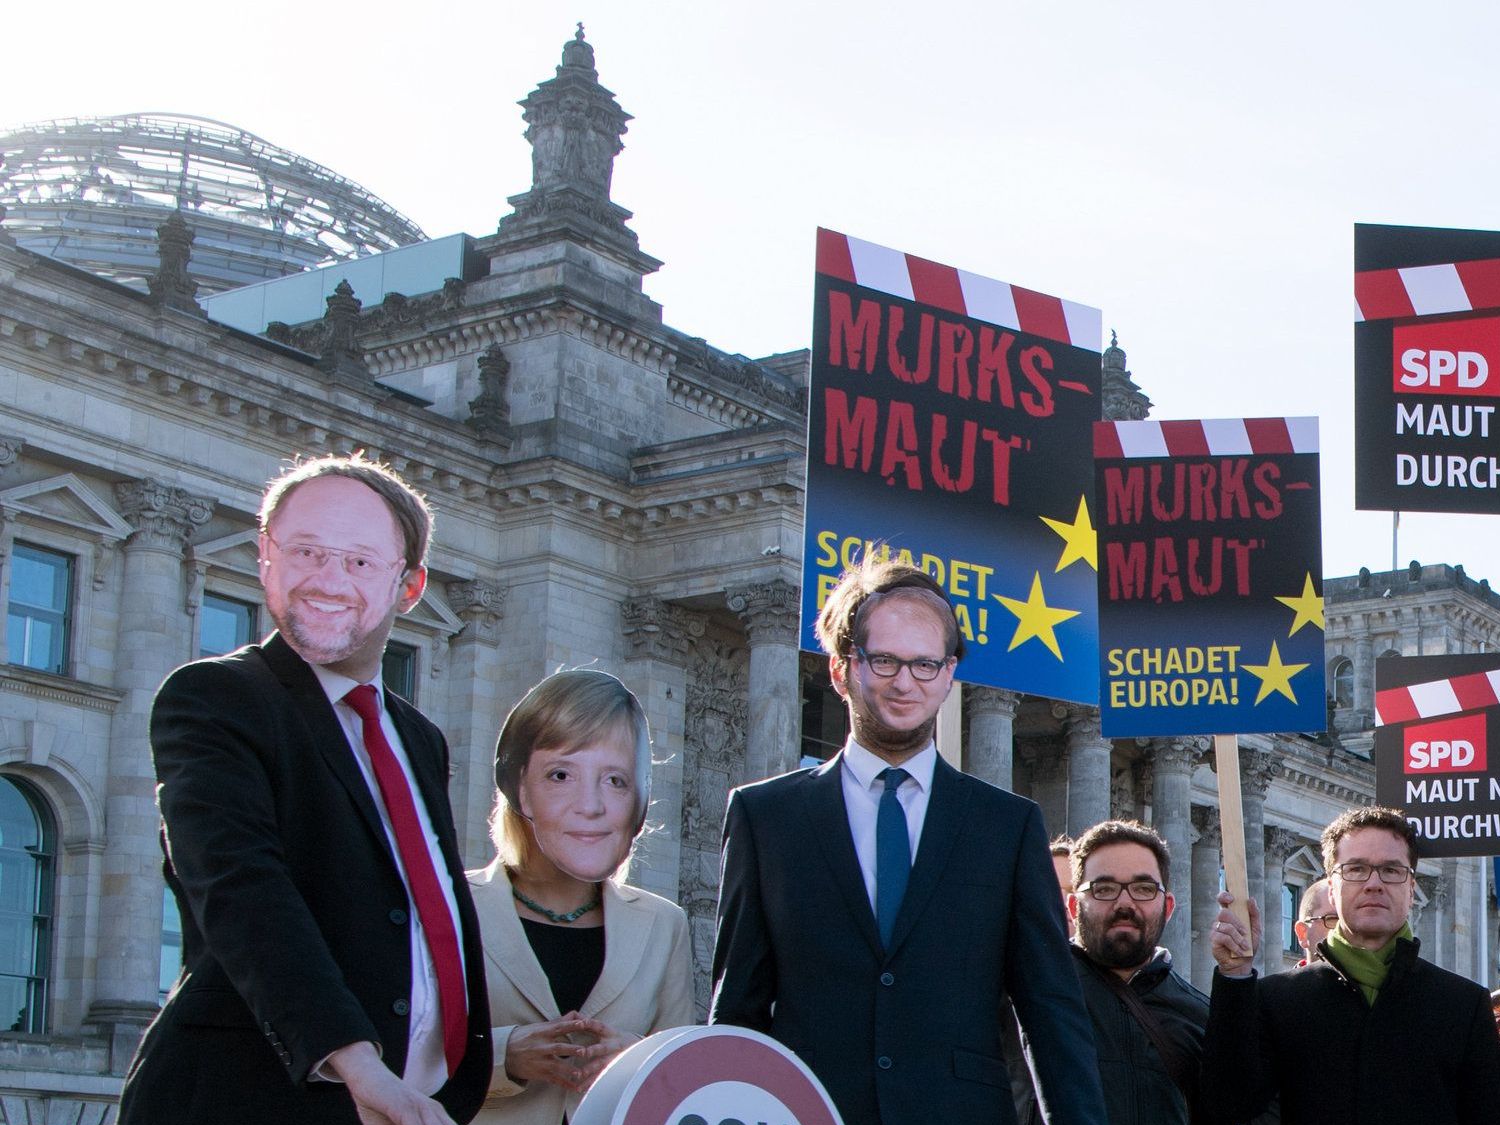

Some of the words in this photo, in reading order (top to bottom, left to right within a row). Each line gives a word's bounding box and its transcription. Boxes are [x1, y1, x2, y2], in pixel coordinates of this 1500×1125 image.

[828, 290, 1093, 418] MURKS-
[1400, 348, 1489, 388] SPD
[1396, 402, 1495, 438] MAUT
[825, 388, 1030, 506] MAUT
[1104, 458, 1313, 526] MURKS-
[1106, 537, 1265, 604] MAUT
[1108, 646, 1241, 676] SCHADET
[1110, 677, 1240, 708] EUROPA!
[1409, 740, 1475, 769] SPD
[1406, 778, 1480, 804] MAUT
